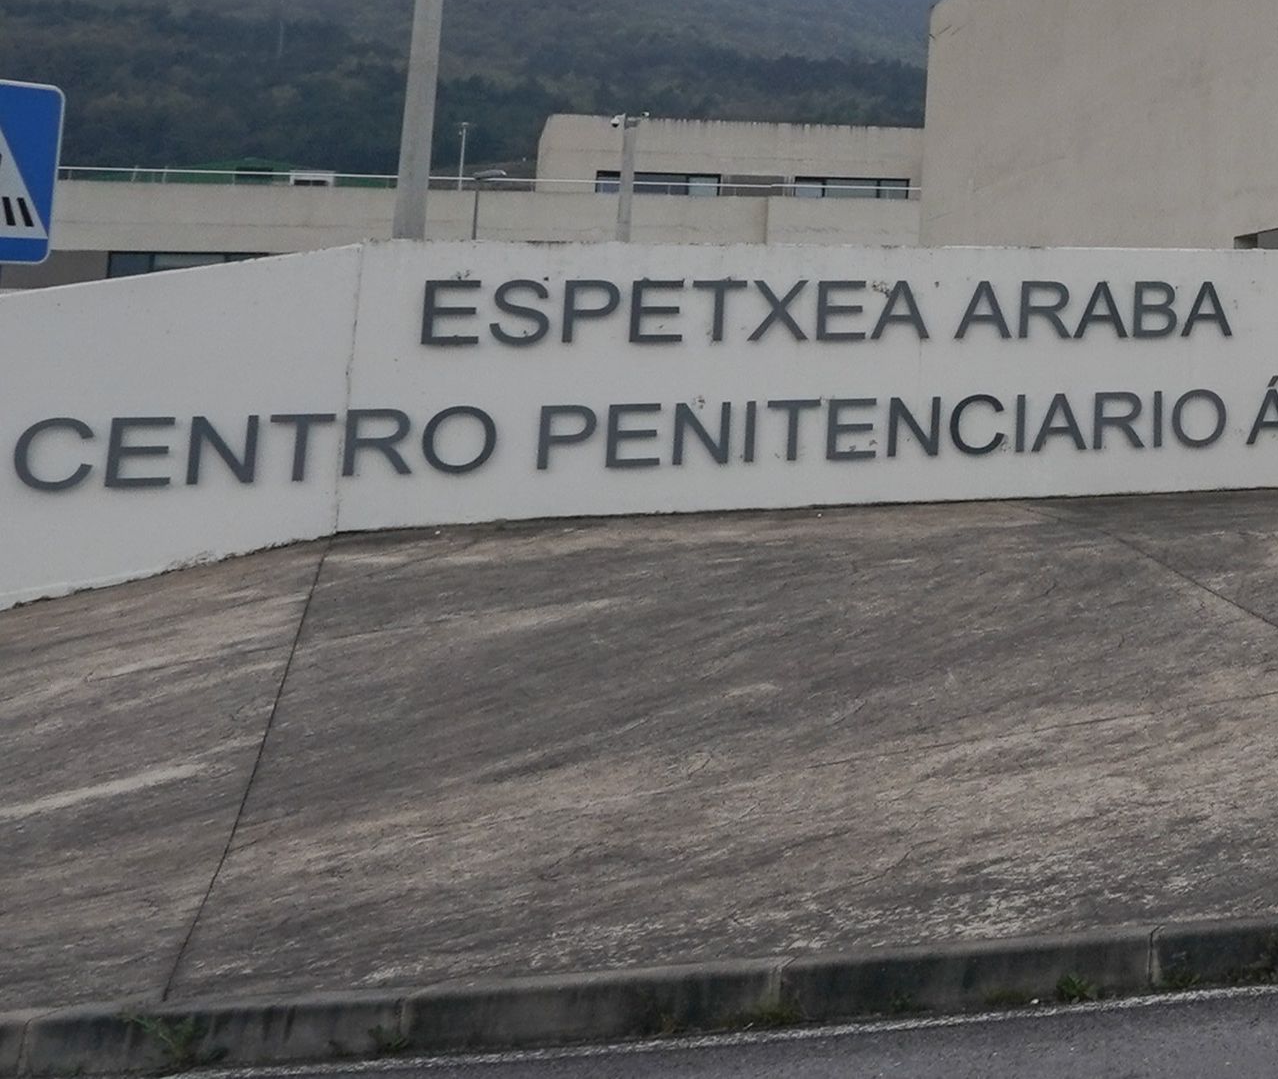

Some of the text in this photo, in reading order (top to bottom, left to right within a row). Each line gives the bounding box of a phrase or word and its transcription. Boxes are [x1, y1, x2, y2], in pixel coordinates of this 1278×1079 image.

[420, 279, 1233, 346] ESPETXEA ARABA
[13, 405, 498, 491] CENTRO
[536, 388, 1227, 471] PENITENCIARIO
